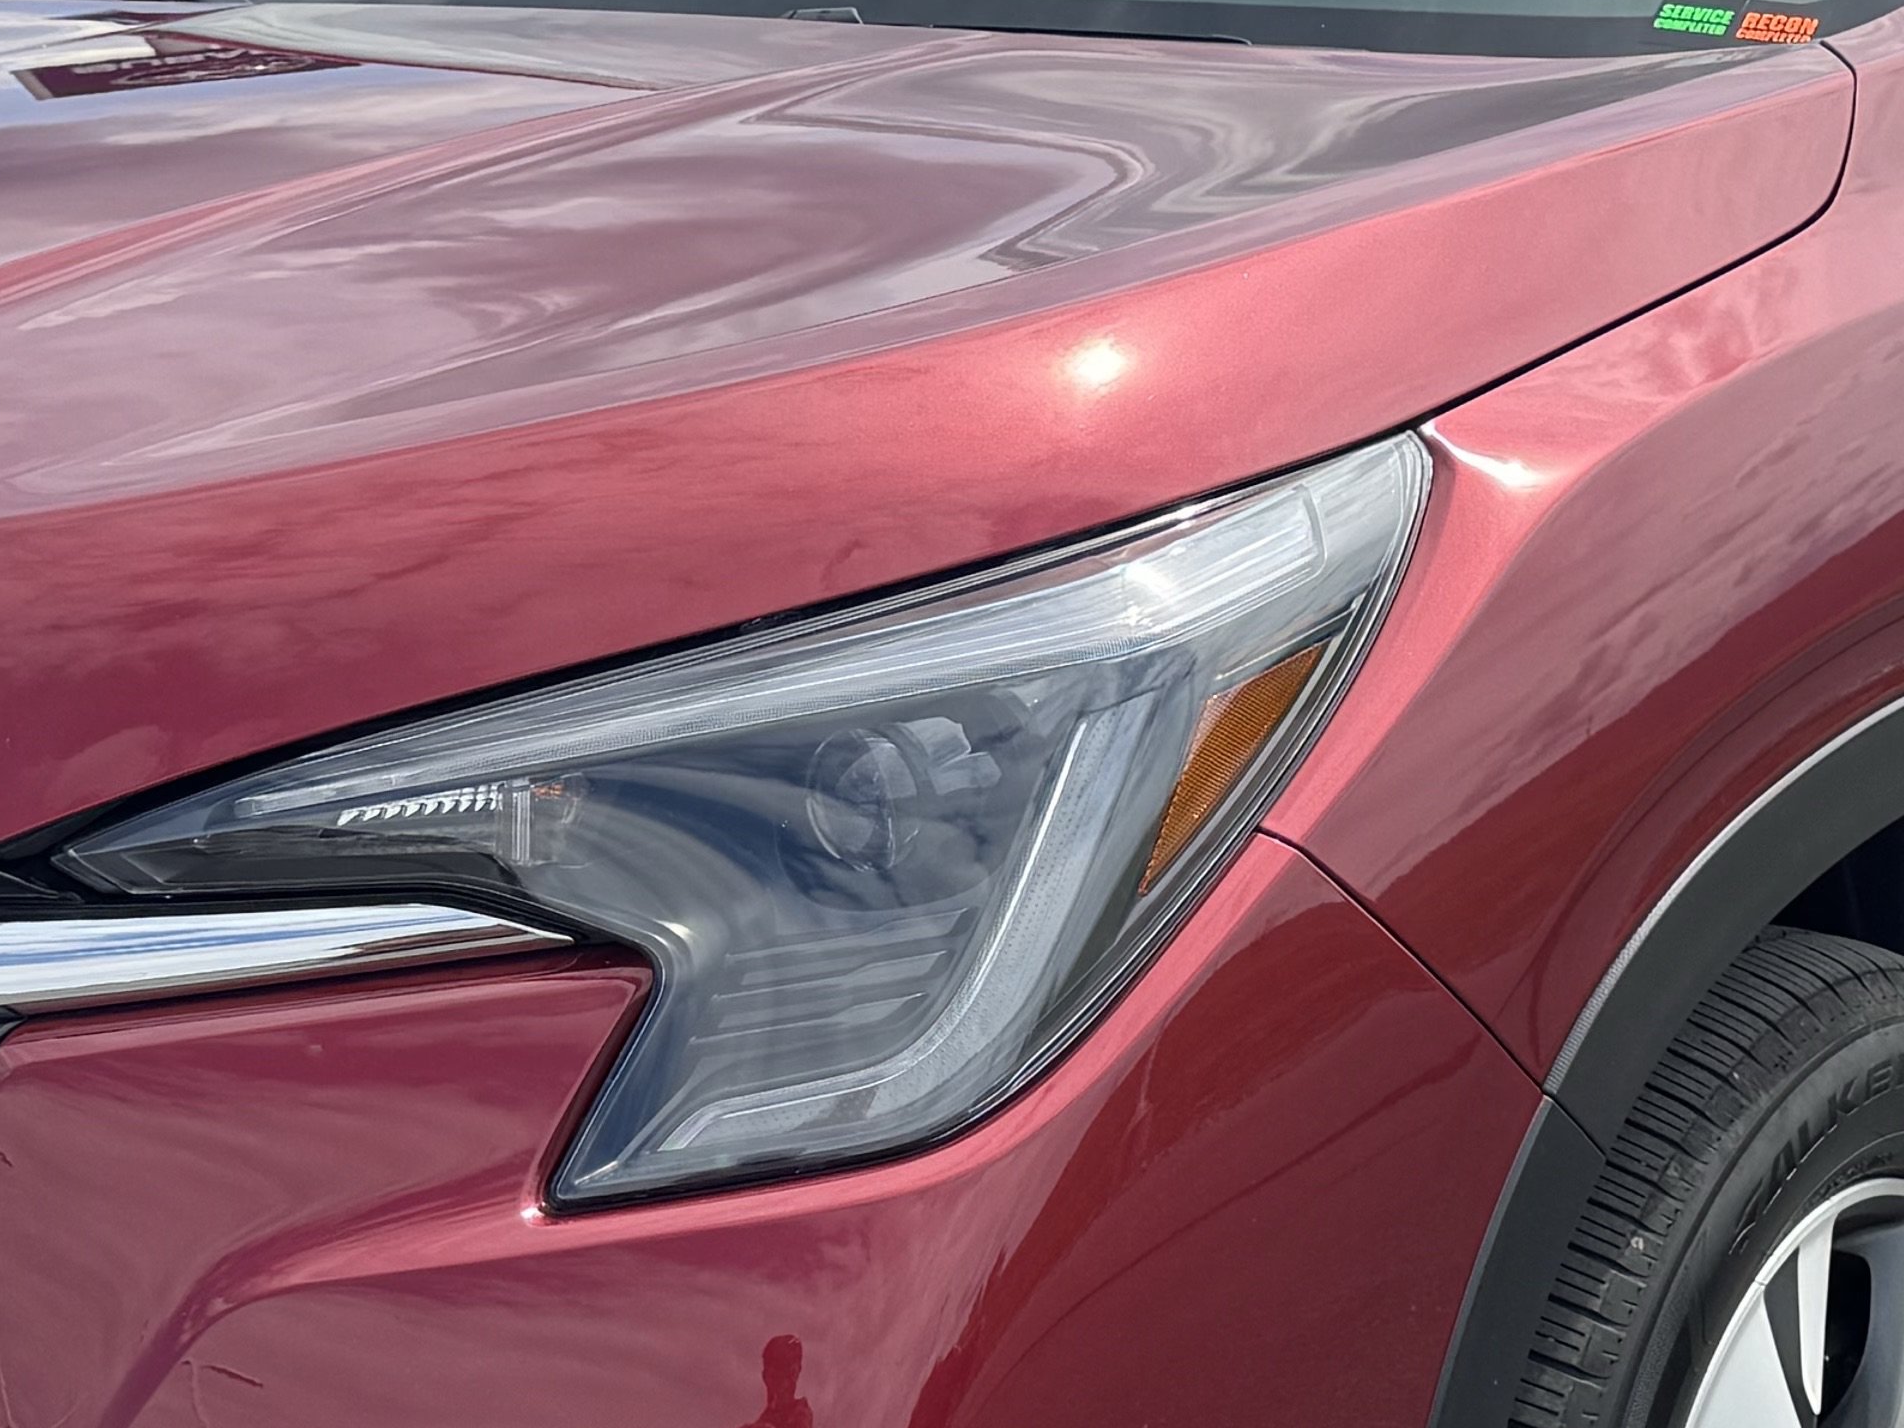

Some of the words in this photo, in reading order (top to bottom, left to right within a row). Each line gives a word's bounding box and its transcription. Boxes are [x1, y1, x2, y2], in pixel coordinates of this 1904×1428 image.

[1659, 3, 1735, 25] SERVICE
[1741, 12, 1819, 36] RECON
[1653, 18, 1728, 36] COMPLETED
